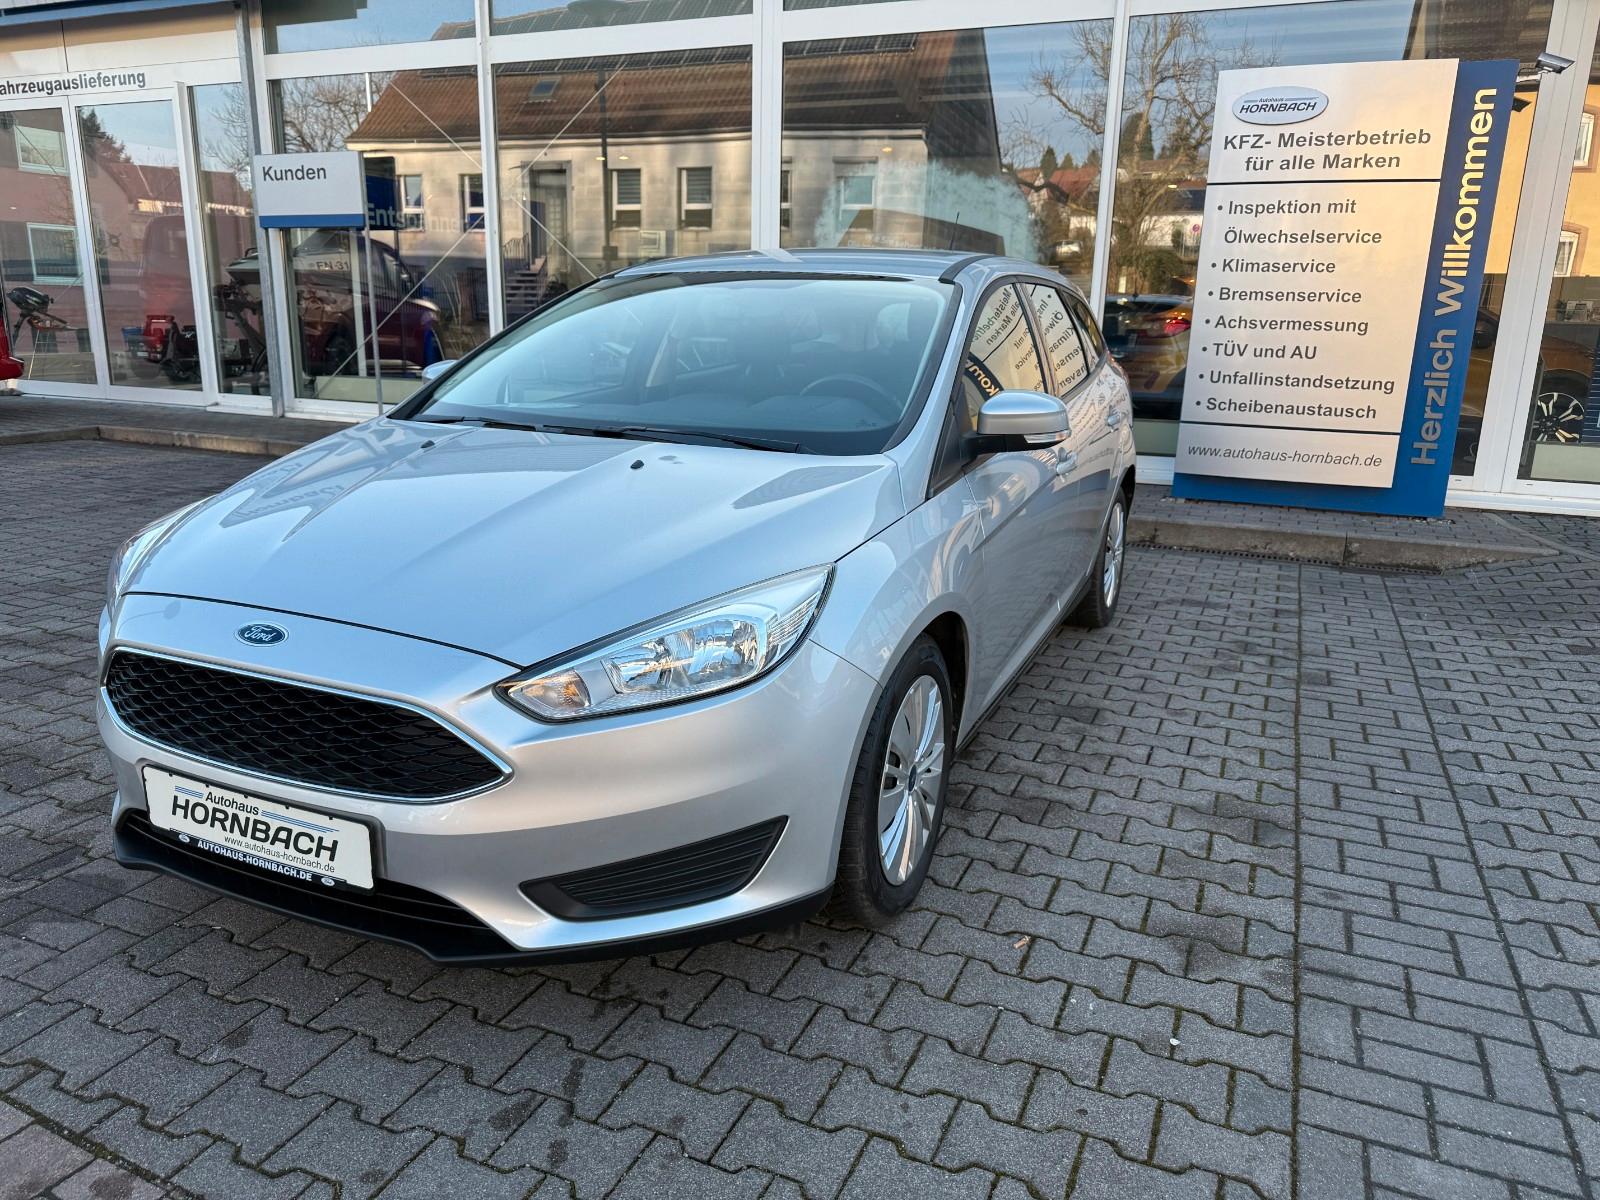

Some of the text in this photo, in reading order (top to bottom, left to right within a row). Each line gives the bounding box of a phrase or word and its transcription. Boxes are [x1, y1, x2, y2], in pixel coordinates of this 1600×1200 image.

[0, 72, 146, 96] ahrzeugauslieferung
[1239, 101, 1317, 114] HORNBACH
[1223, 128, 1431, 150] KFZ- Meisterbetrieb
[1245, 152, 1401, 172] für alle Marken
[262, 164, 327, 182] Kunden
[1228, 198, 1357, 218] Inspektion mit
[1224, 227, 1382, 244] Ölwechselservice
[1221, 258, 1336, 274] Klimaservice
[1411, 88, 1497, 465] Herzlich Willkommen
[1218, 287, 1362, 304] Bremsenservice
[1214, 315, 1369, 336] Achsvermessung
[1212, 340, 1317, 360] TÜV und AU
[1209, 370, 1396, 395] Unfallinstandsetzung
[1206, 397, 1377, 420] Scheibenaustausch
[1187, 444, 1382, 468] www.autohaus-hornbach.de
[244, 625, 277, 642] Ford
[205, 791, 260, 816] Autohaus
[171, 795, 339, 862] HORNBACH
[197, 840, 313, 881] AUTOHAUS-HORNBACH.DE
[224, 835, 335, 873] www.autohaus-hornbach.de
